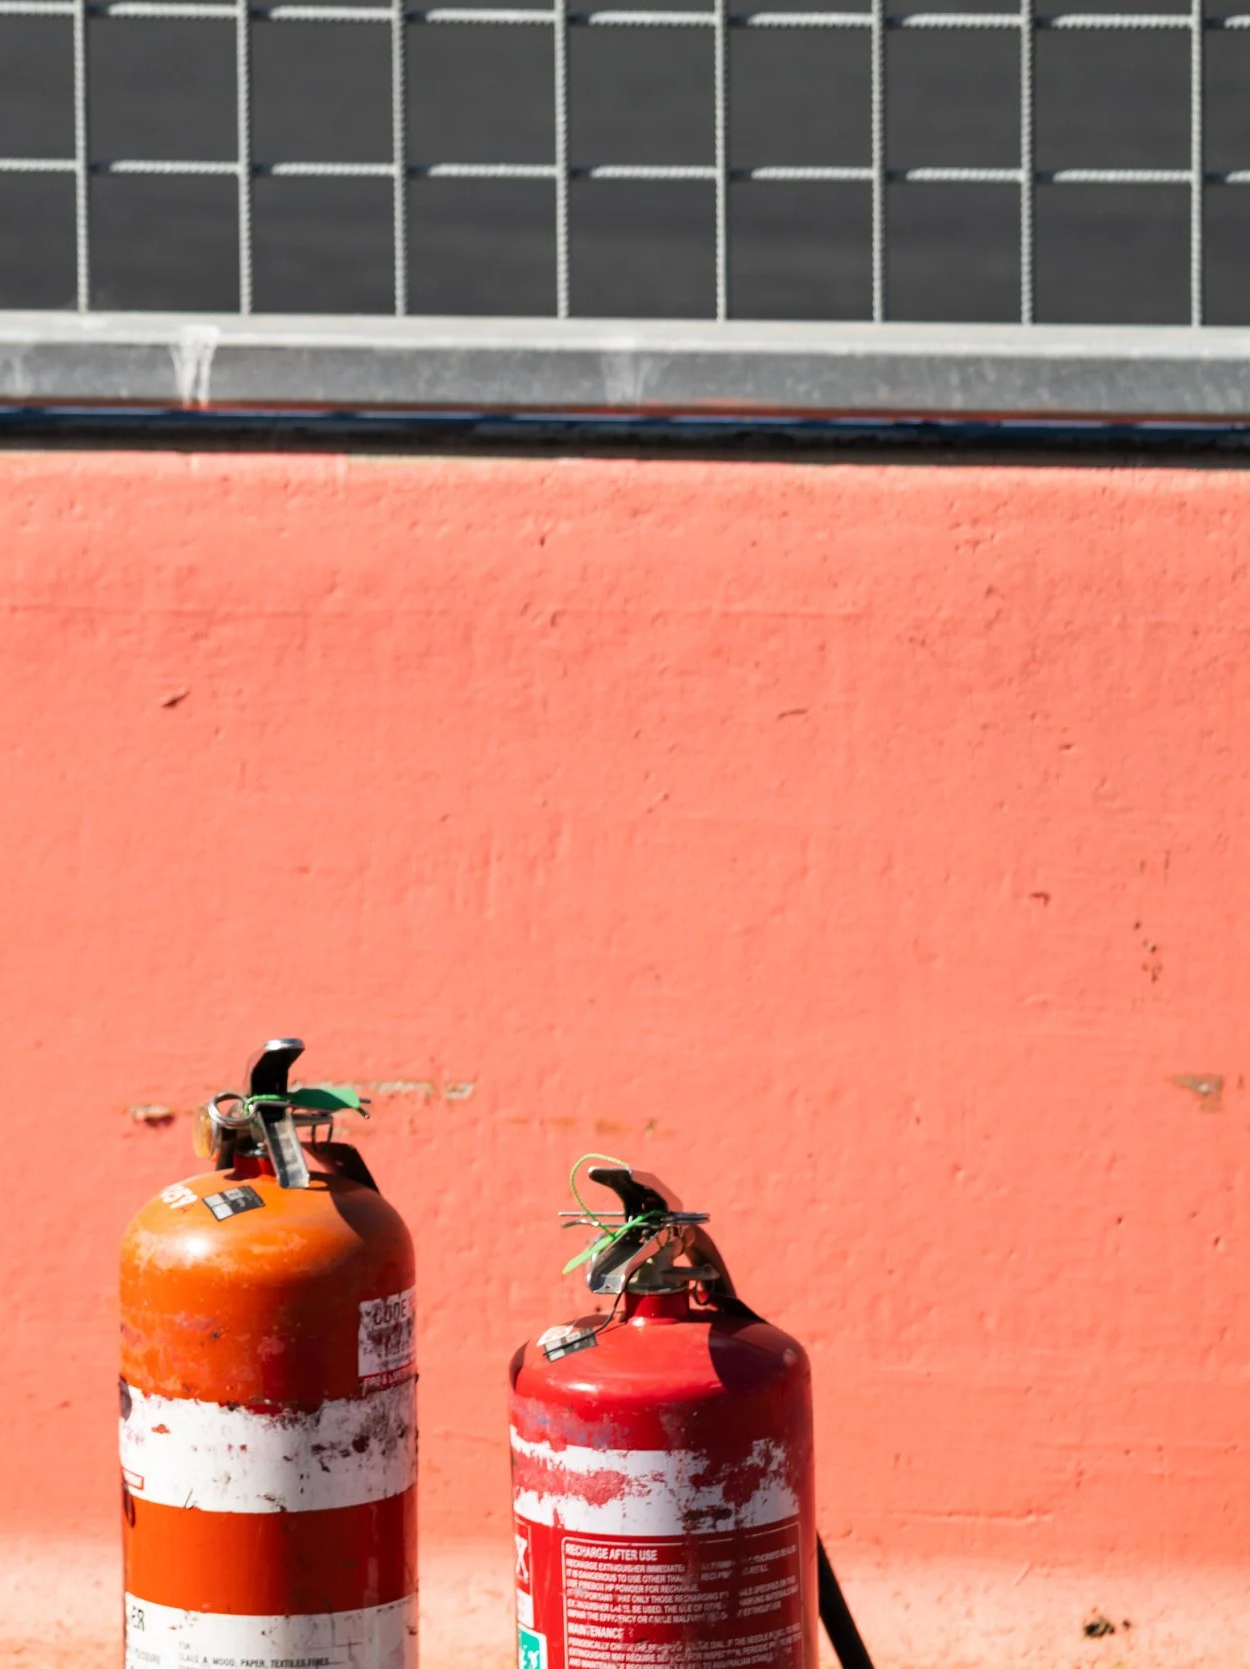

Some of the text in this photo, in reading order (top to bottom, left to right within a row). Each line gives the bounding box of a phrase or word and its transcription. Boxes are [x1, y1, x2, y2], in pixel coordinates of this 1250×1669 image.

[565, 1543, 658, 1561] RECHARGE AFTER USE
[618, 1573, 627, 1583] TO
[627, 1574, 641, 1583] USE
[642, 1574, 666, 1584] OTHER
[615, 1583, 644, 1594] POWDER
[645, 1584, 659, 1593] FOR
[631, 1594, 649, 1604] ONLY
[651, 1594, 674, 1604] THOSE
[632, 1604, 642, 1613] BE
[665, 1604, 678, 1613] THE
[637, 1615, 648, 1623] OR
